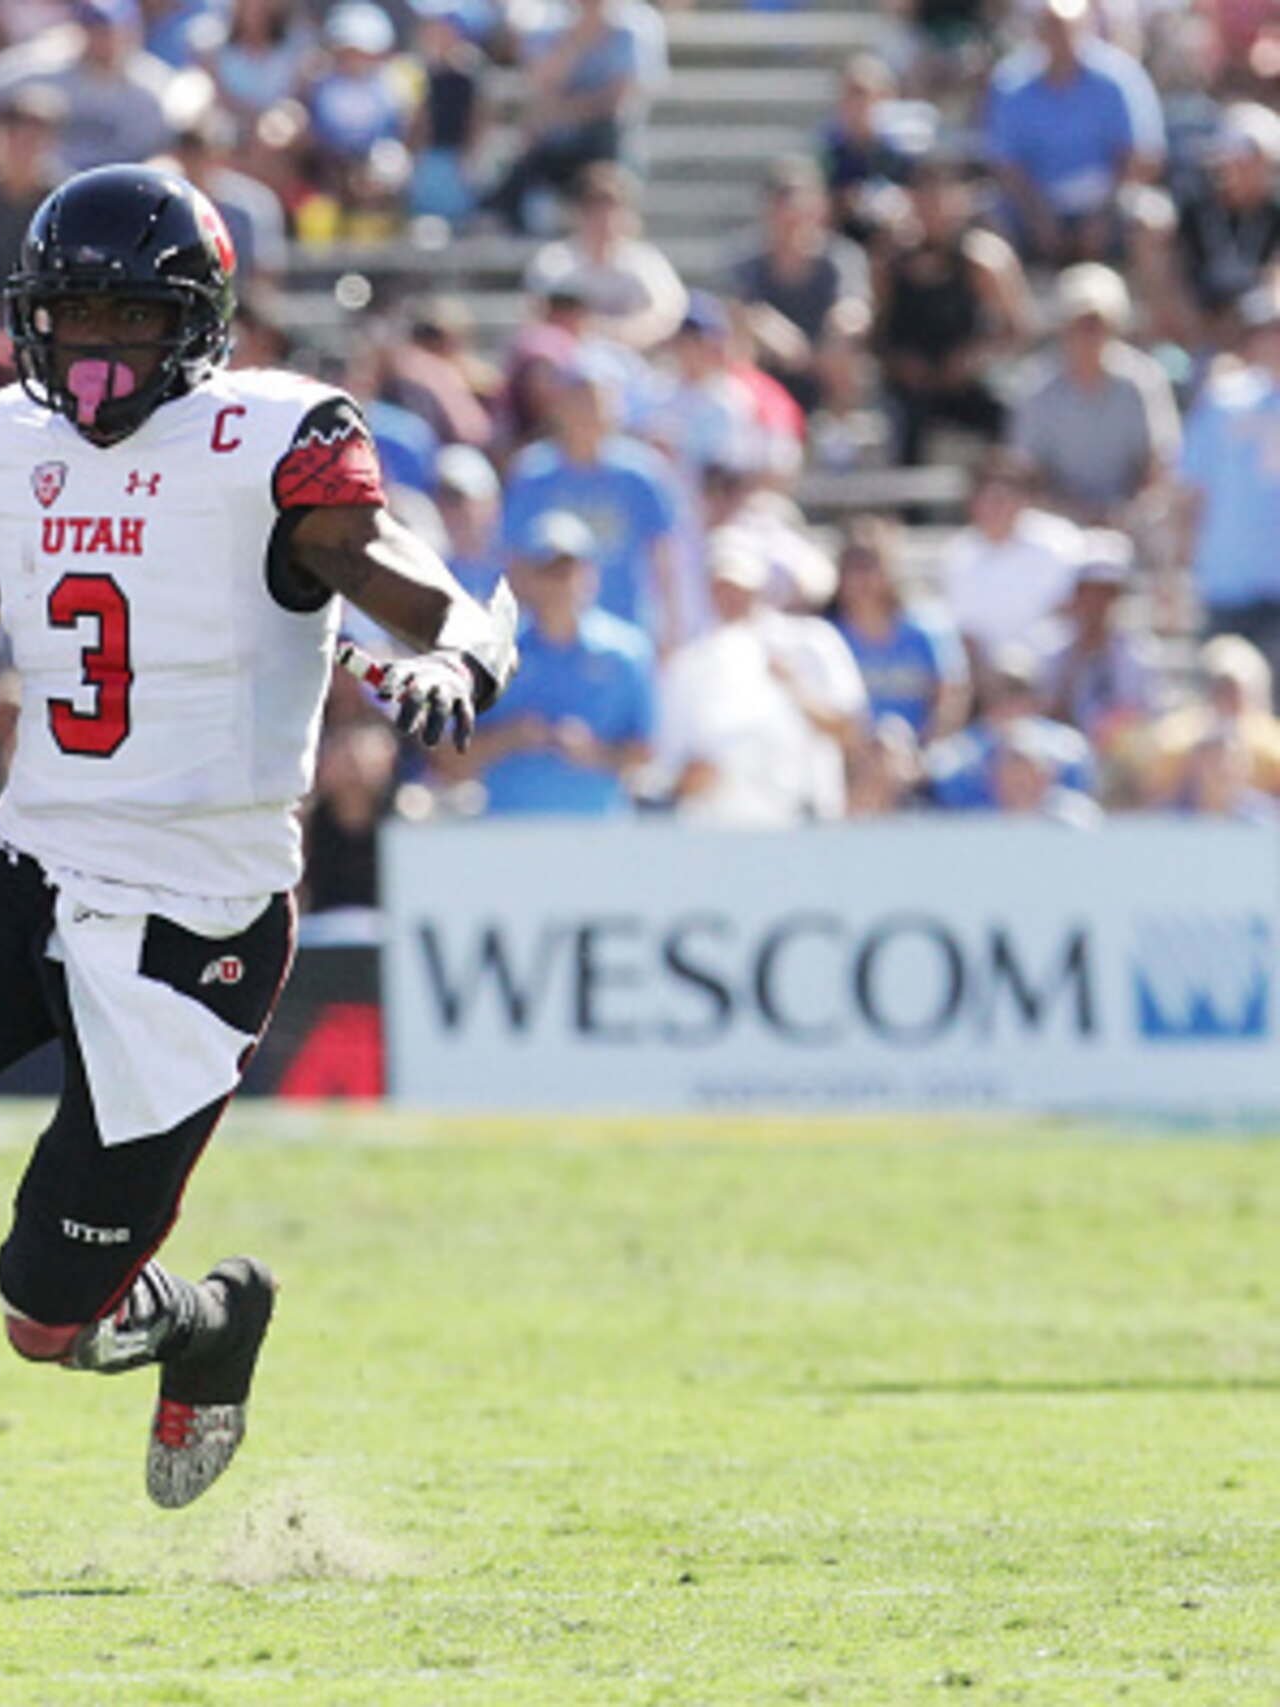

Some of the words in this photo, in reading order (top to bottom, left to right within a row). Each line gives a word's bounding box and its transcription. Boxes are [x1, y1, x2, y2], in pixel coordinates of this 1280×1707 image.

[210, 405, 246, 453] C
[41, 517, 146, 556] UTAH
[47, 572, 134, 759] 3
[415, 910, 1100, 1046] WESCOM
